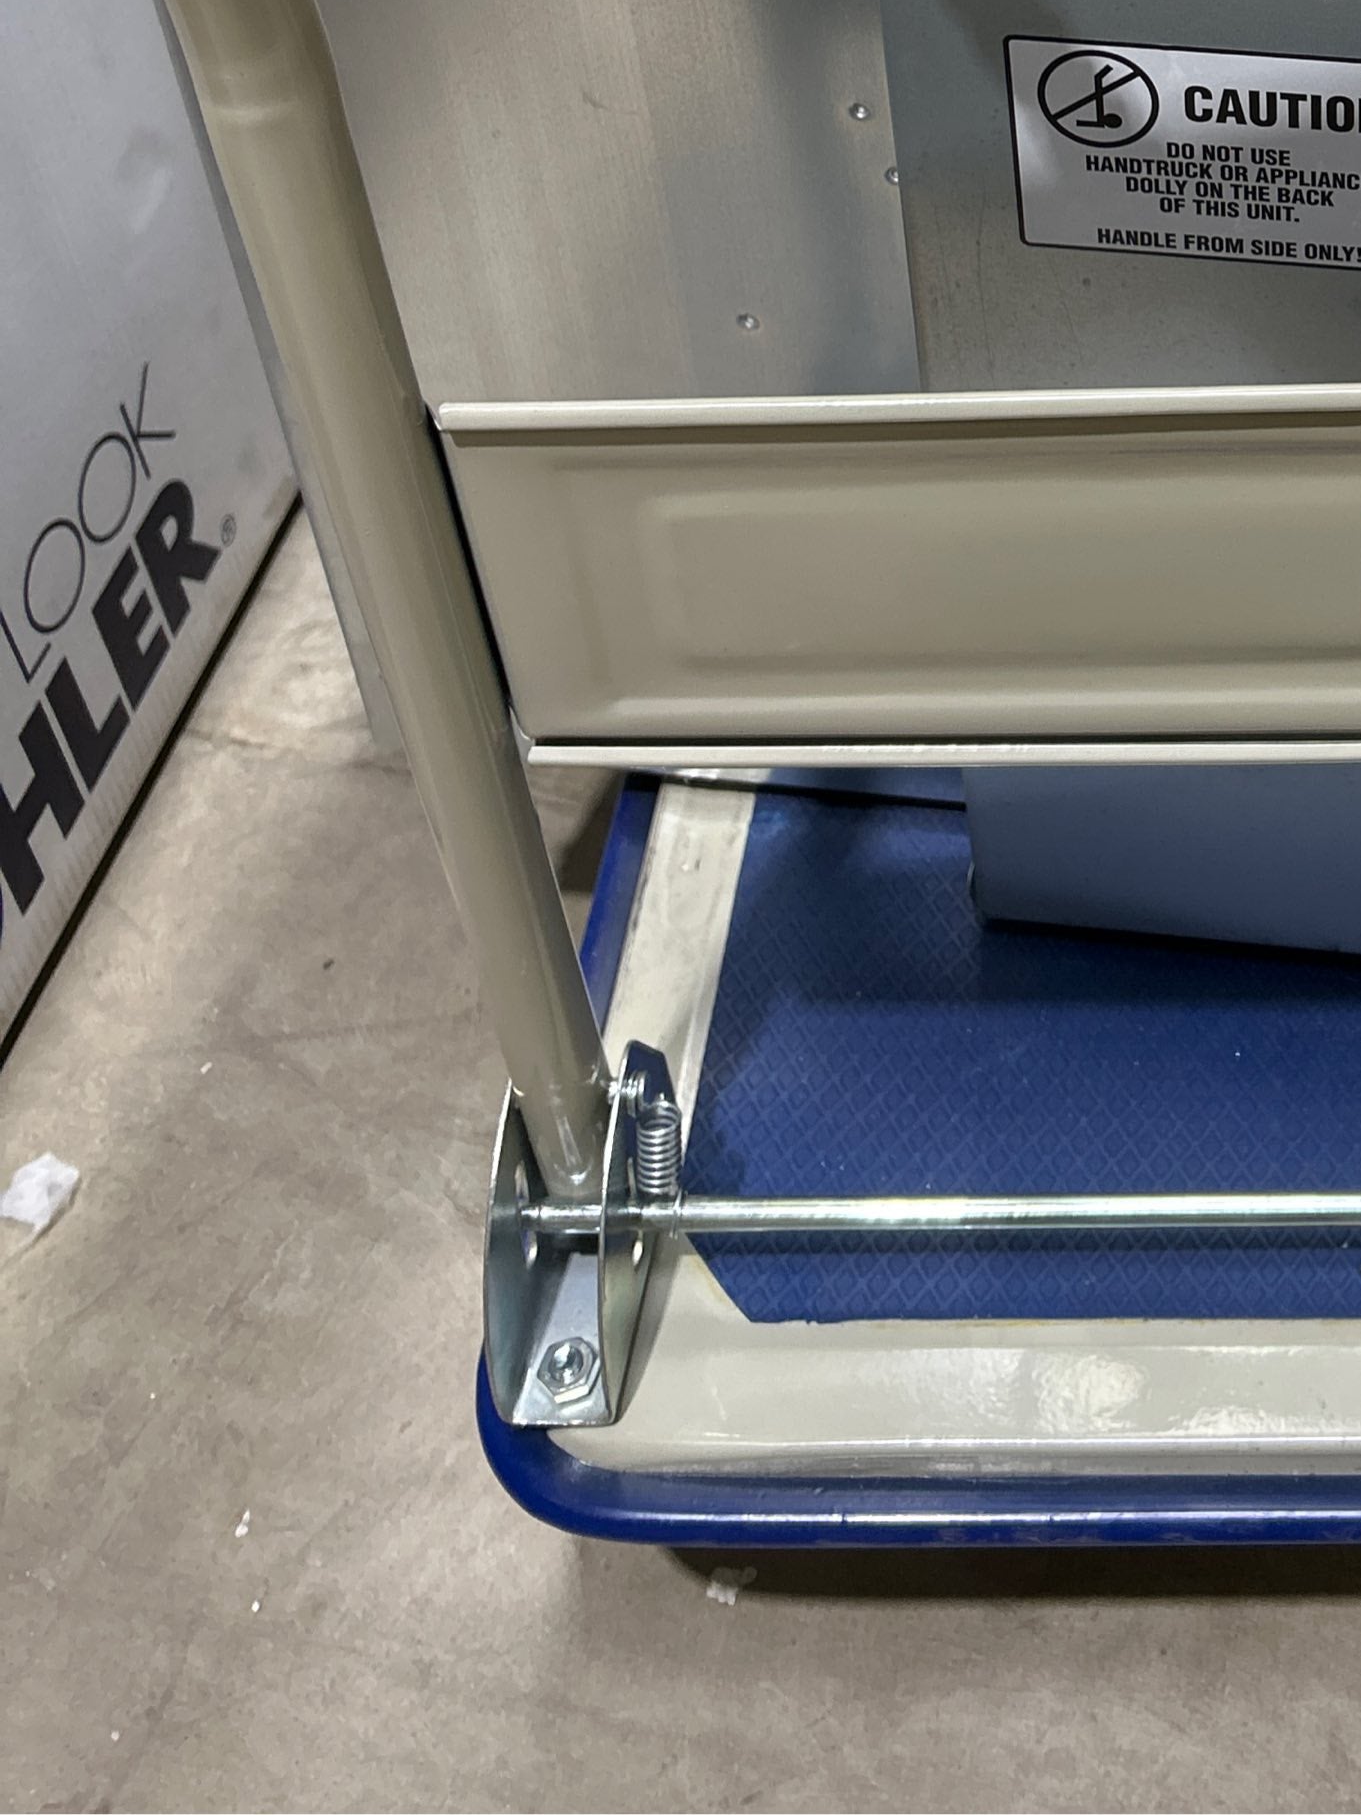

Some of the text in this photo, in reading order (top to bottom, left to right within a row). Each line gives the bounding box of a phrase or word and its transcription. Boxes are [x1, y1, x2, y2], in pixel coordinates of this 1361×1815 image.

[1086, 155, 1212, 180] HANDTRUCK
[1219, 165, 1249, 182] OR
[1167, 142, 1291, 167] DO NOT USE
[1125, 176, 1335, 207] DOLLY ON THE BACK
[1160, 196, 1300, 223] OF THIS UNIT.
[1098, 228, 1177, 249] HANDLE
[1184, 235, 1244, 254] FROM
[1250, 240, 1298, 258] SIDE
[0, 362, 176, 684] LOOK
[0, 478, 221, 926] HLER
